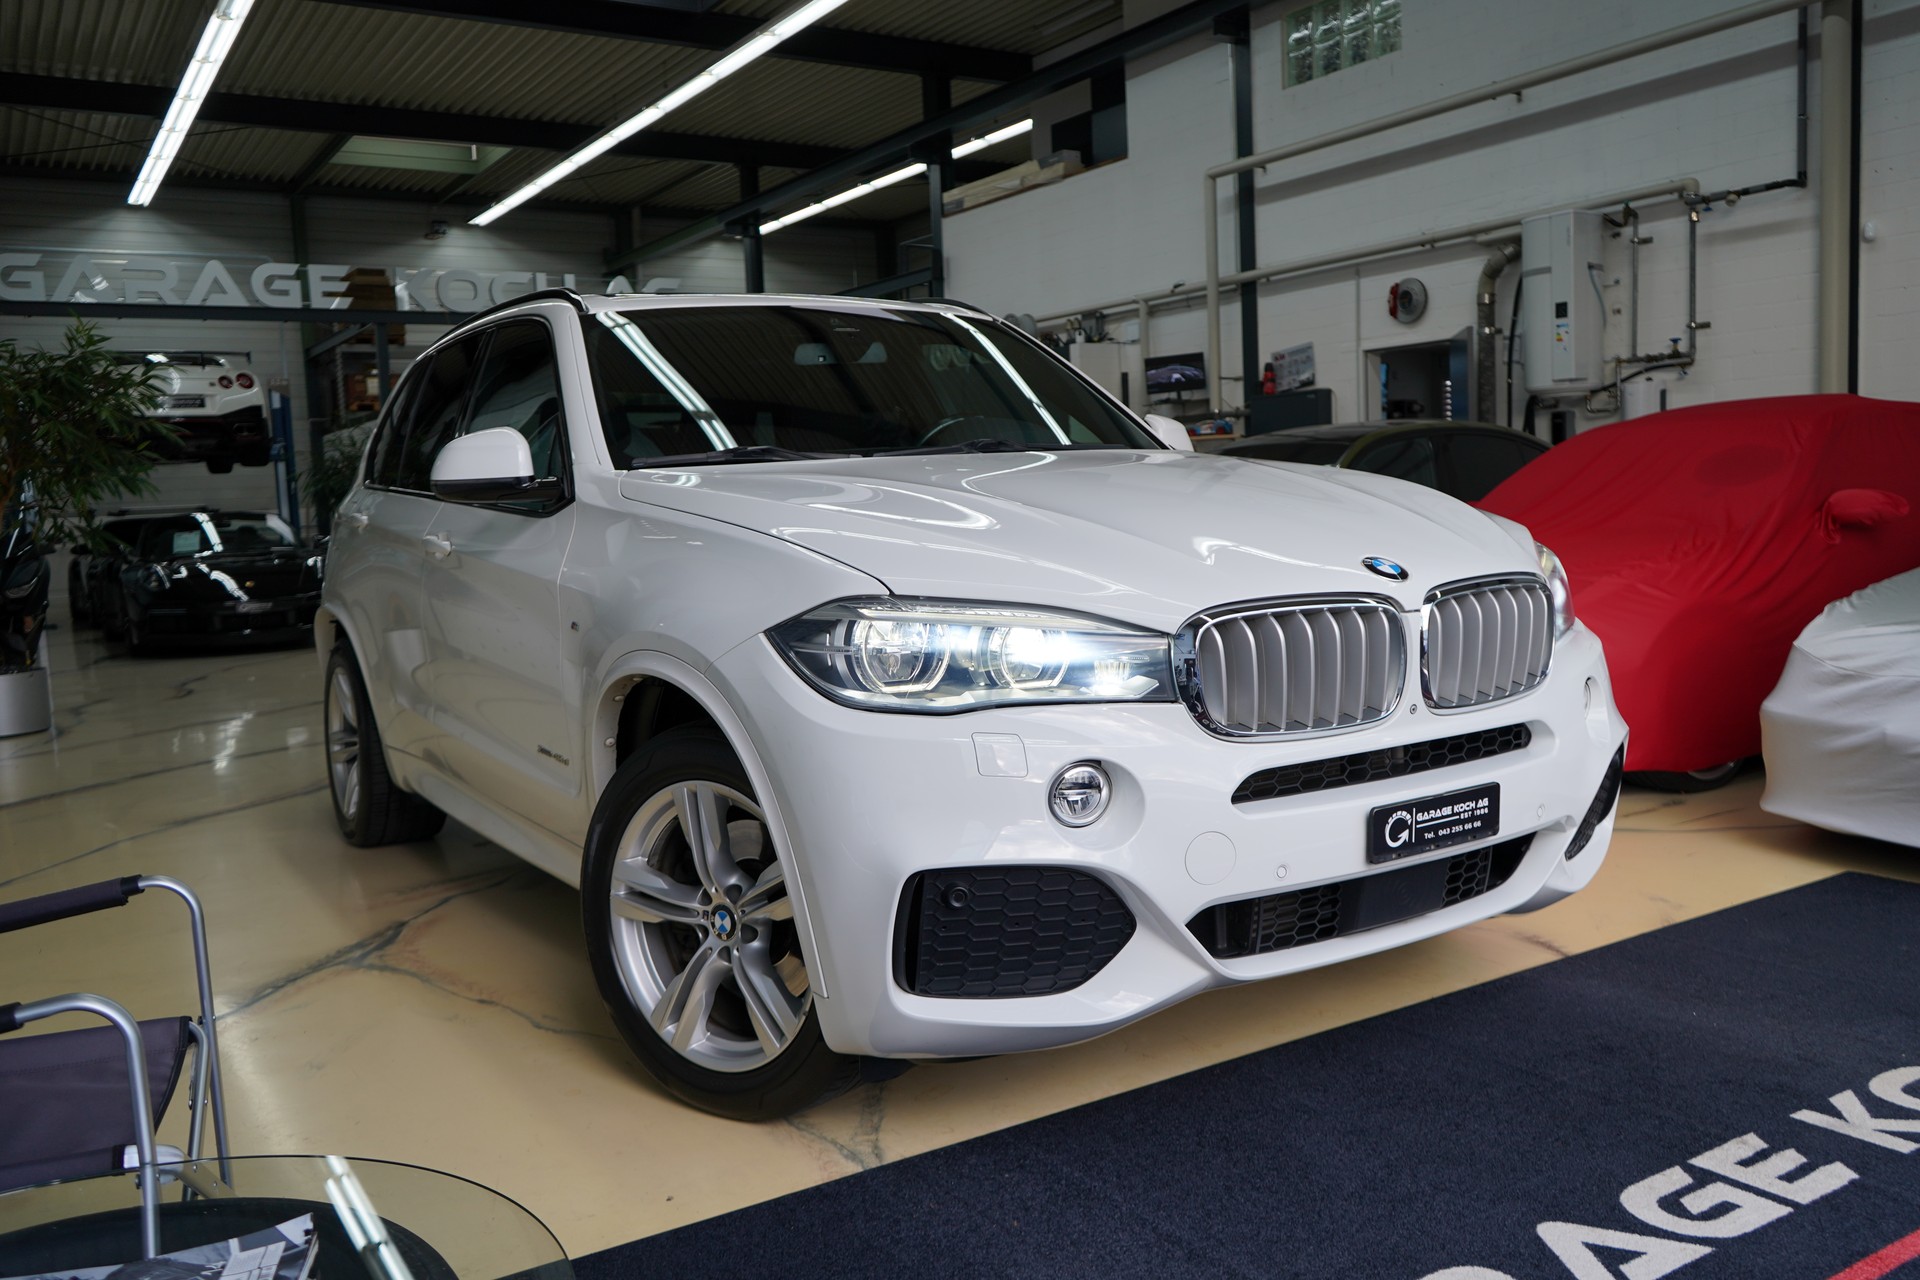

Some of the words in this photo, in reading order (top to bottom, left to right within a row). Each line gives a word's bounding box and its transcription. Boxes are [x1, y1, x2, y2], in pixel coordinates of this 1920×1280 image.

[0, 253, 355, 310] GARAGE
[1416, 806, 1453, 821] GARAGE
[1453, 800, 1476, 813] KOCH
[1476, 797, 1489, 808] AG
[1460, 811, 1472, 820] EST
[1424, 831, 1436, 840] Tel.
[1438, 828, 1451, 836] 043
[1451, 825, 1464, 833] 255
[1464, 822, 1473, 830] 66
[1473, 820, 1482, 828] 66
[1416, 1131, 1859, 1280] AGE
